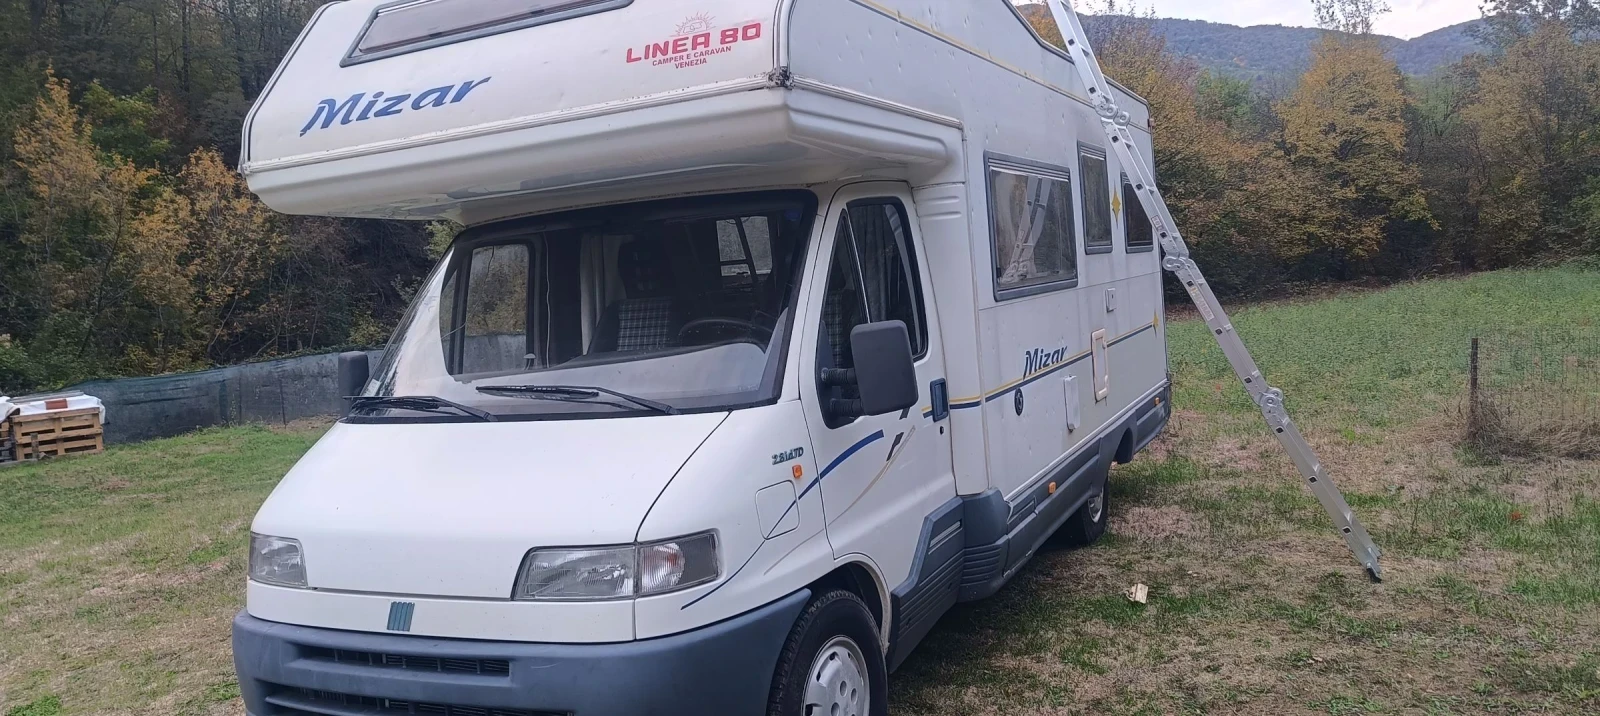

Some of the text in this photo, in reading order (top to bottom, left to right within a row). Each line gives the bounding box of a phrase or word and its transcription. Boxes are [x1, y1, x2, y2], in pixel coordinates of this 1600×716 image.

[626, 22, 761, 63] LINEA 80
[652, 55, 684, 67] CAMPER
[693, 45, 732, 59] CARAVAN
[674, 57, 707, 69] VENEZIA
[299, 76, 492, 137] Mizar
[1023, 346, 1068, 381] Mizar
